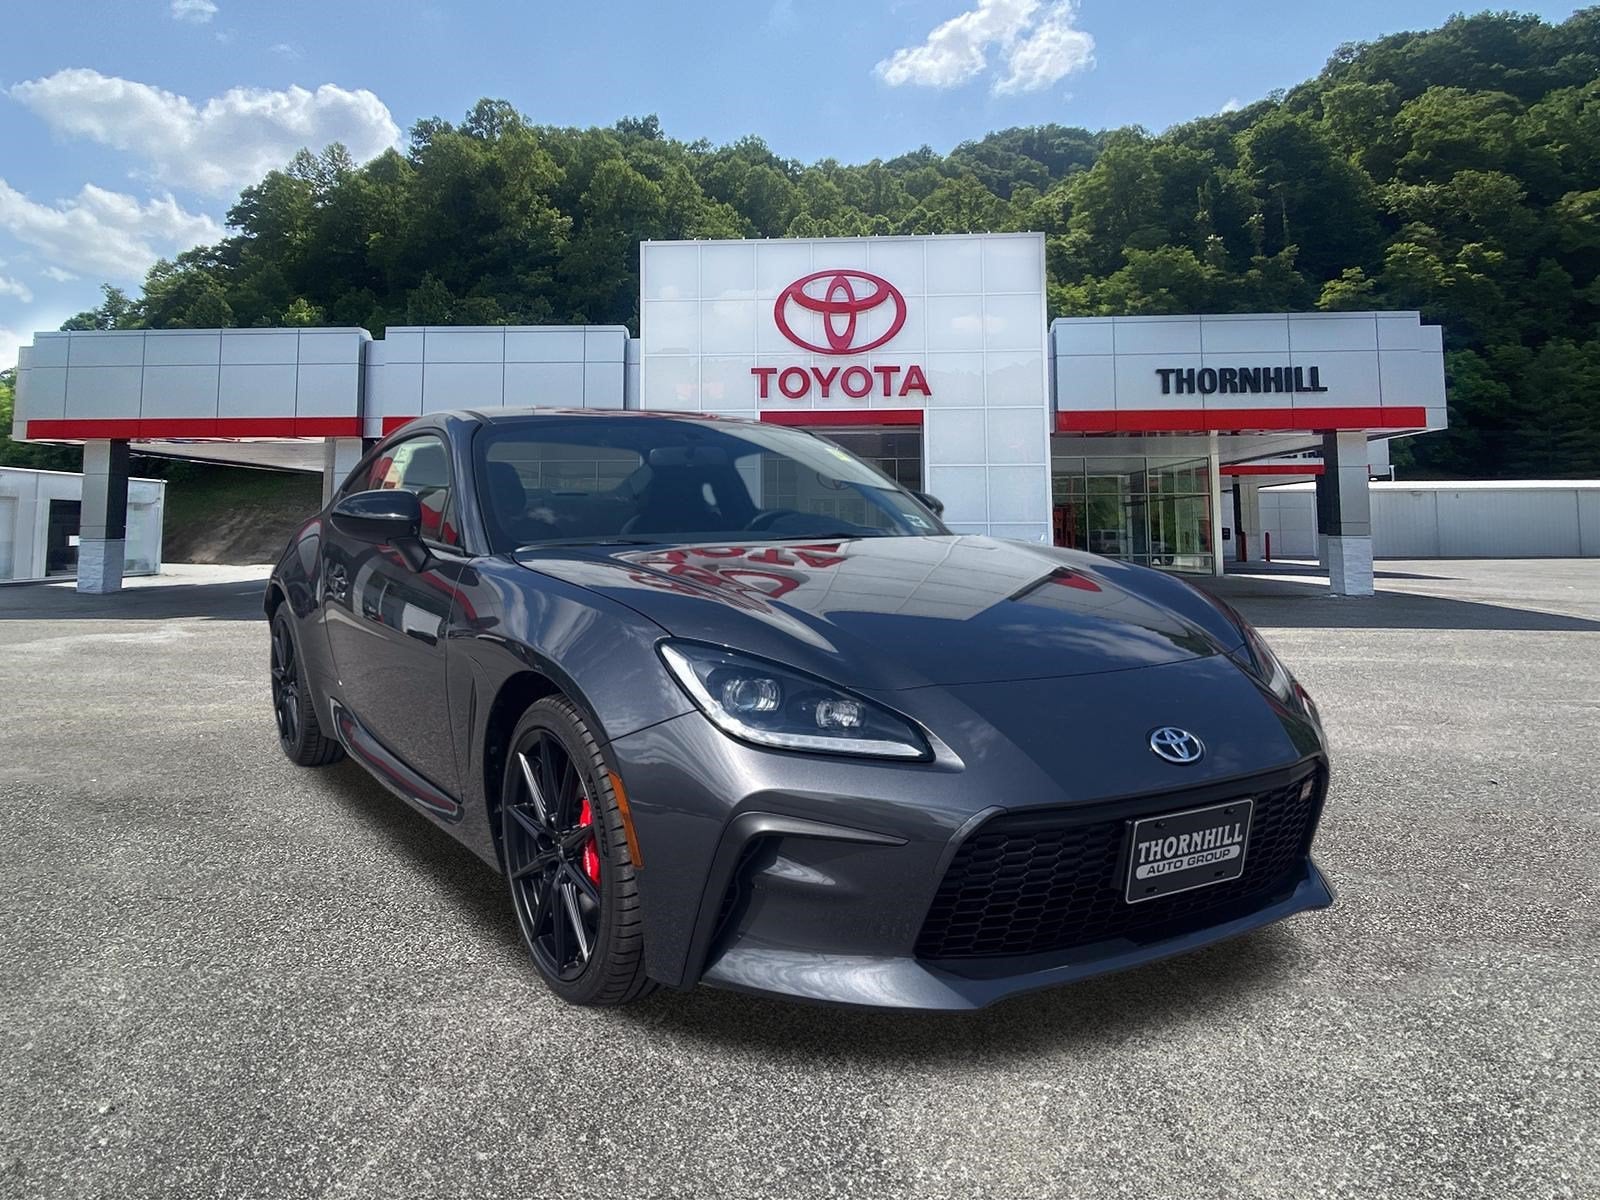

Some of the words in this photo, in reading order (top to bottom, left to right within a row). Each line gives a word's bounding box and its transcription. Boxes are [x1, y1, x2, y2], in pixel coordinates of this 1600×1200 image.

[751, 365, 932, 399] TOYOTA
[1155, 366, 1328, 394] THORNHILL
[1138, 823, 1243, 863] THORNHILL
[1146, 859, 1183, 876] AUTO
[1187, 849, 1231, 866] GROUP
